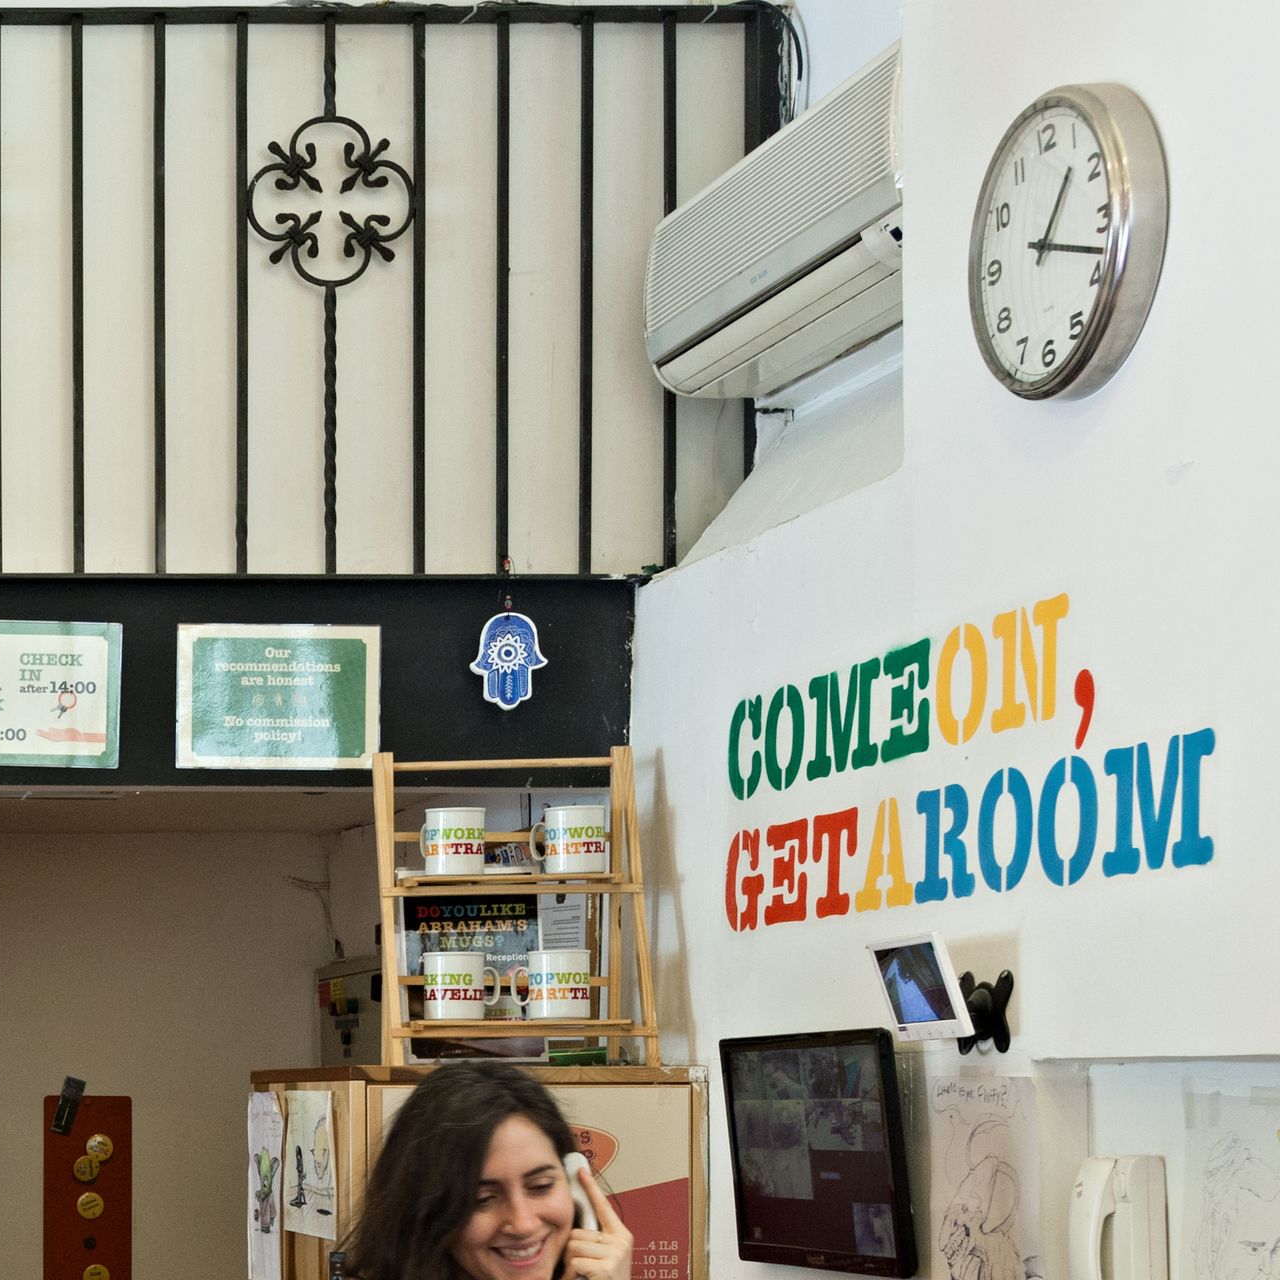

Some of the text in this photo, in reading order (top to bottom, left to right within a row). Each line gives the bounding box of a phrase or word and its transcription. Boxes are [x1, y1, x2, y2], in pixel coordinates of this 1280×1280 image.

[1037, 123, 1057, 155] 12
[1014, 157, 1025, 186] 11
[1087, 152, 1101, 182] 2
[995, 202, 1011, 232] 10
[1096, 204, 1110, 234] 3
[987, 259, 1002, 286] 9
[1089, 260, 1102, 288] 4
[996, 306, 1013, 334] 8
[1069, 311, 1085, 341] 5
[1016, 336, 1029, 365] 7
[1041, 339, 1056, 368] 6
[19, 653, 83, 667] CHECK
[264, 647, 291, 658] Our
[19, 669, 43, 682] IN
[214, 661, 341, 673] recommendations
[19, 681, 97, 695] after 14:00
[241, 675, 314, 686] are honest
[224, 715, 331, 728] No commission
[418, 919, 528, 933] ABRAHAM'S
[659, 1240, 679, 1250] ILS
[659, 1255, 679, 1265] ILS
[659, 1269, 679, 1279] ILS
